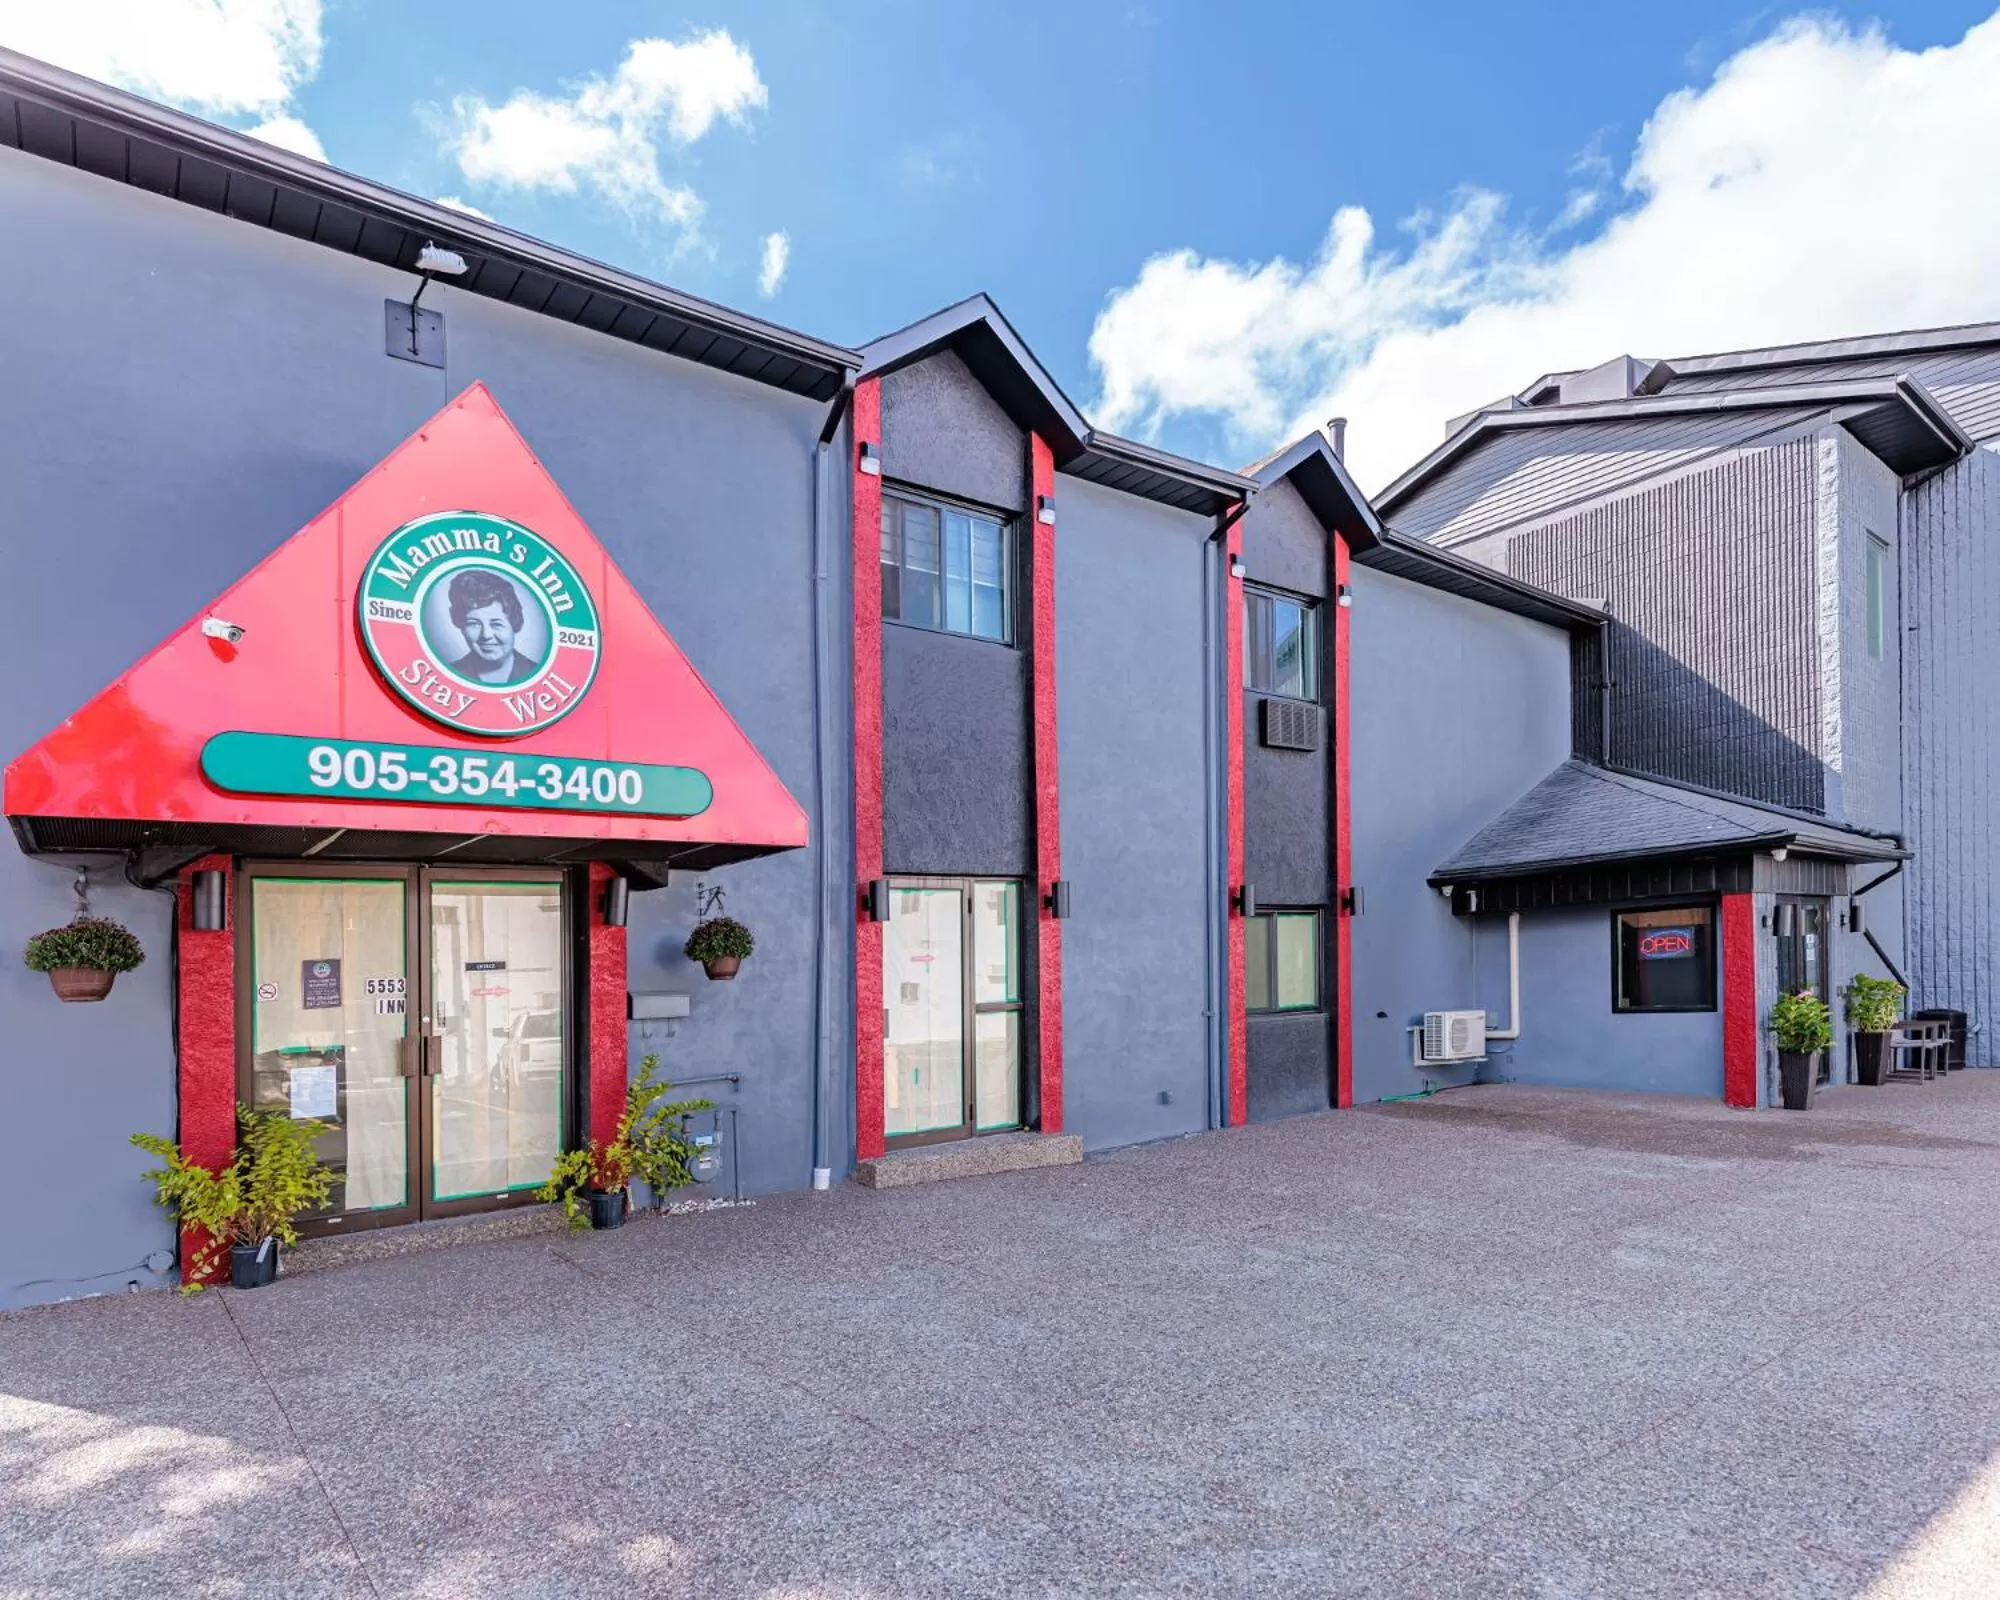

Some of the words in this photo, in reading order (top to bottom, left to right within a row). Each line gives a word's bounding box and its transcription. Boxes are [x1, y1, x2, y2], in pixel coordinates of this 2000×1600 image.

[377, 528, 527, 591] Mamma's
[530, 554, 576, 614] Inn
[369, 601, 412, 621] Since
[559, 631, 595, 647] 2021
[399, 658, 480, 717] Stay
[502, 672, 578, 724] Well
[308, 745, 643, 805] 905-354-3400
[1640, 934, 1690, 953] OPEN
[367, 979, 405, 994] 5553
[379, 999, 405, 1014] INN
